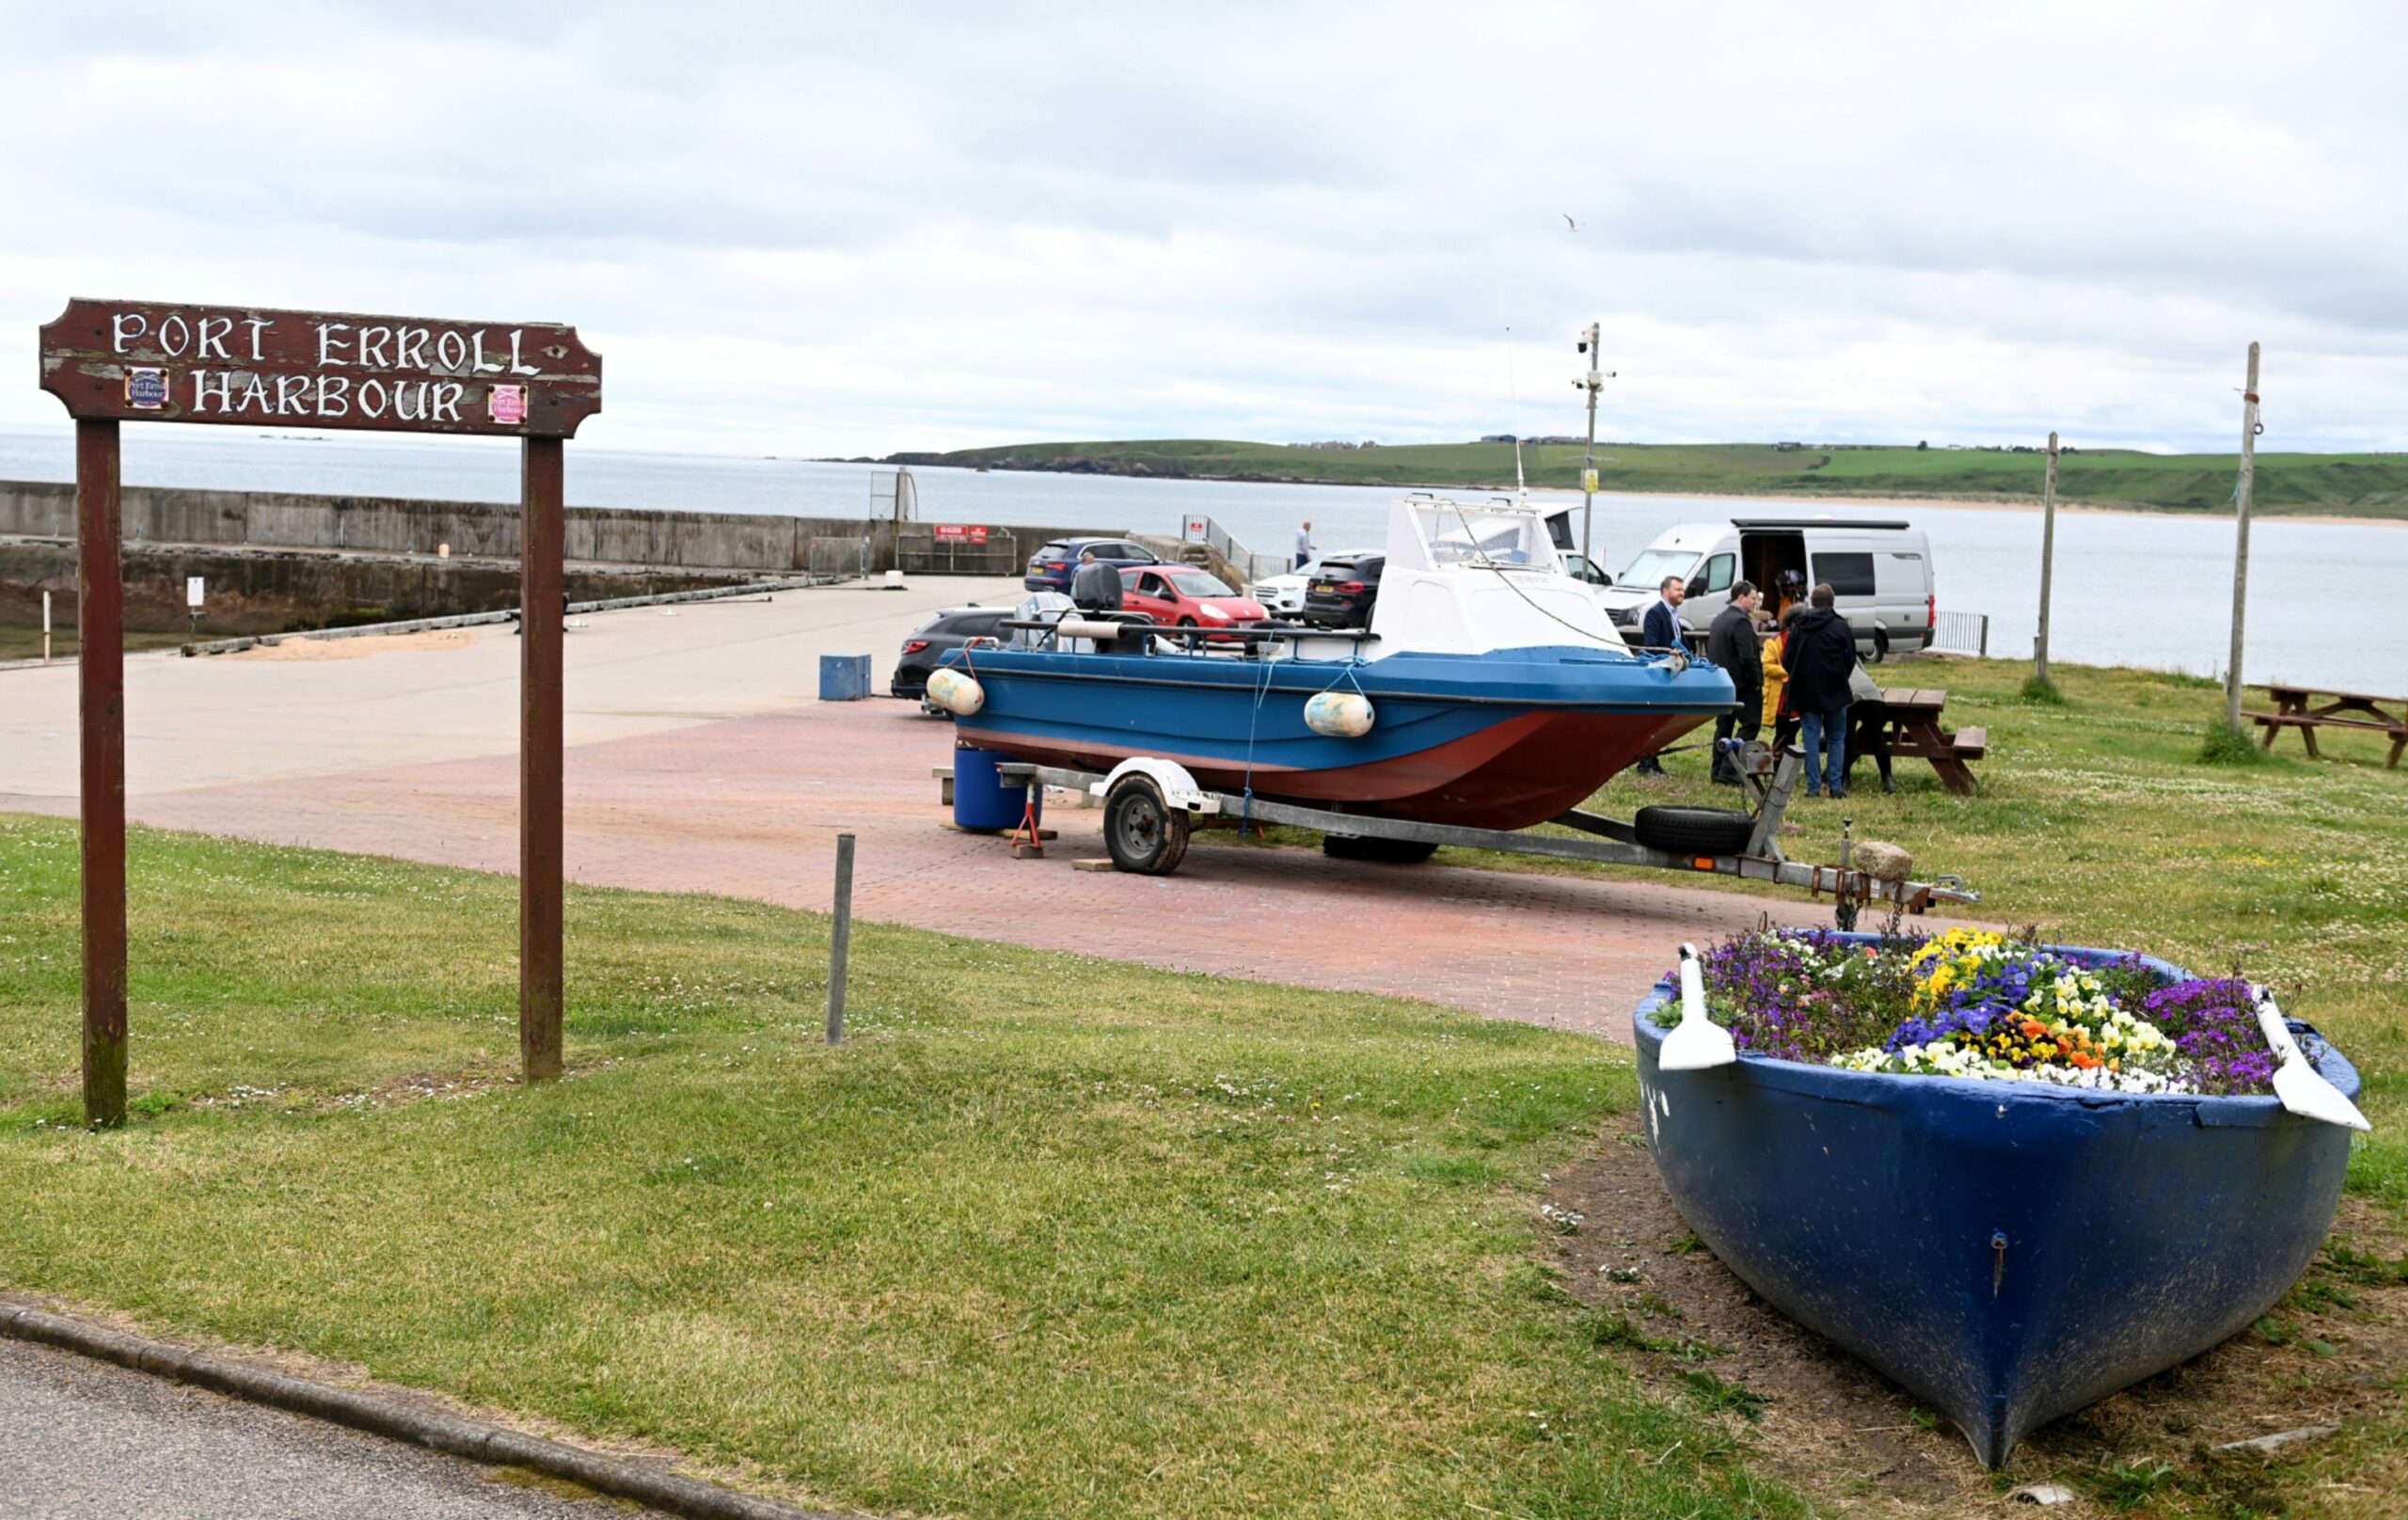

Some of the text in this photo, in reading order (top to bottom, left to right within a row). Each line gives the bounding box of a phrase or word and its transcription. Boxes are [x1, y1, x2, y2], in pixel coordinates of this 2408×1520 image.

[112, 312, 543, 376] PORT ERROLL
[189, 369, 464, 422] HARBOUR
